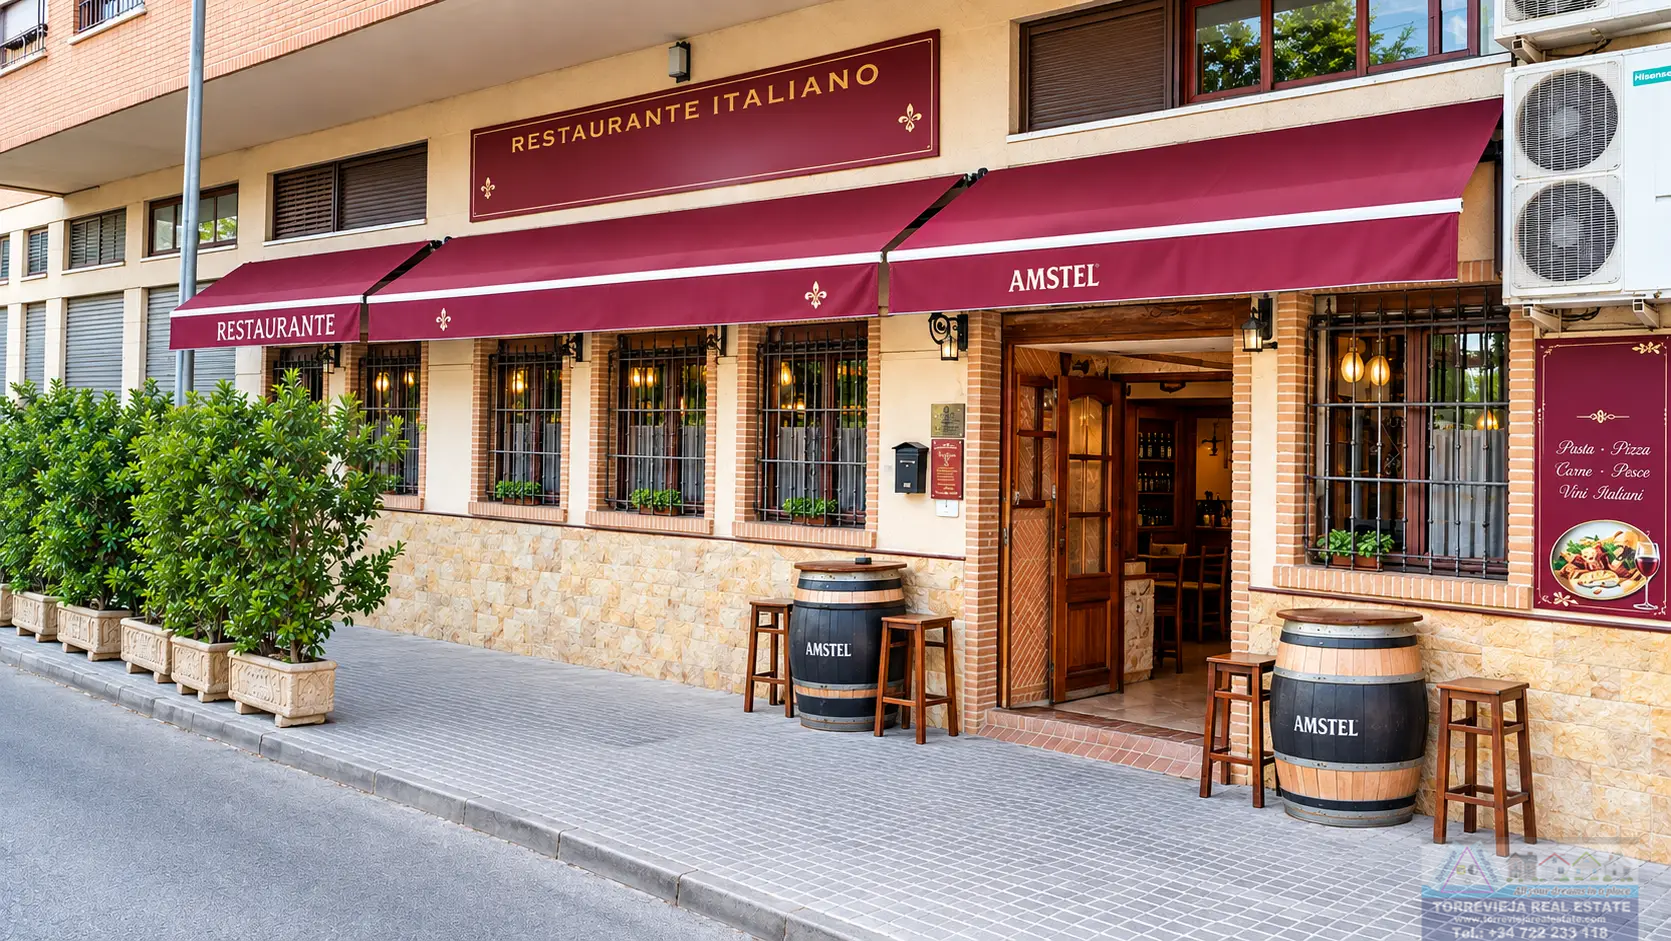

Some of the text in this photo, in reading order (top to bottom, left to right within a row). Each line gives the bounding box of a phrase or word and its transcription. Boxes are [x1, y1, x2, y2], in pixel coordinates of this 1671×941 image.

[511, 63, 880, 154] RESTAURANTE ITALIANO
[1008, 263, 1100, 292] AMSTEL
[216, 313, 335, 341] RESTAURANTE
[1556, 440, 1651, 456] Pasta Pizza
[1555, 461, 1651, 478] Carne Pesce
[1559, 484, 1644, 501] Vini Italiani
[805, 641, 852, 657] AMSTEL
[1294, 715, 1359, 736] AMSTEL
